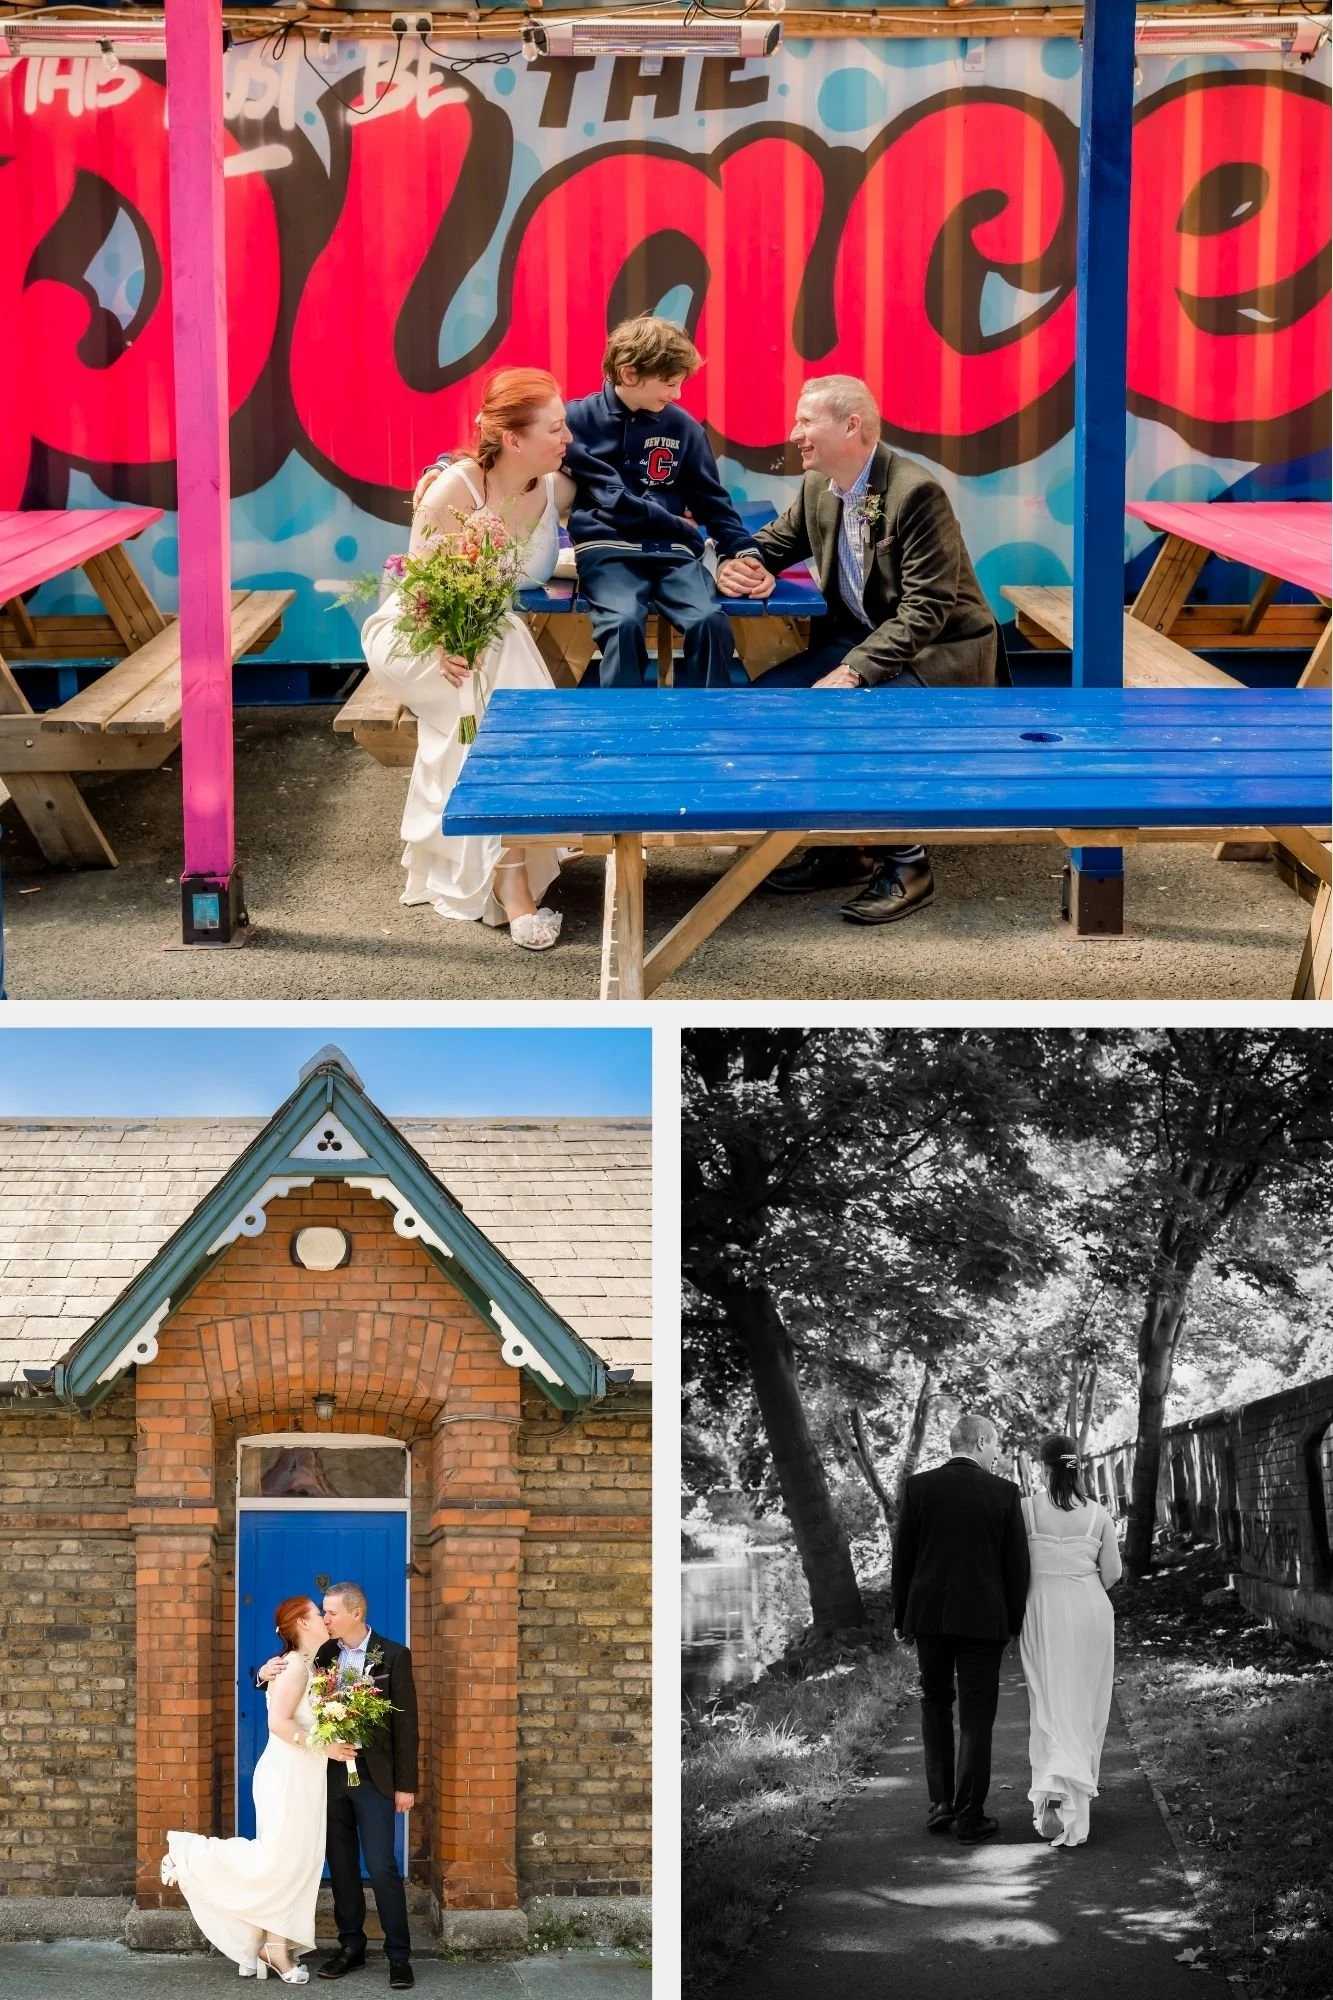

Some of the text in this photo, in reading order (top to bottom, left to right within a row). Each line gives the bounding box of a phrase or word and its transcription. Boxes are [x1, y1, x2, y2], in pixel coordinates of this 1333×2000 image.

[345, 44, 469, 125] BE
[526, 55, 770, 129] THE
[644, 436, 680, 449] NEW YORK
[647, 447, 673, 480] C
